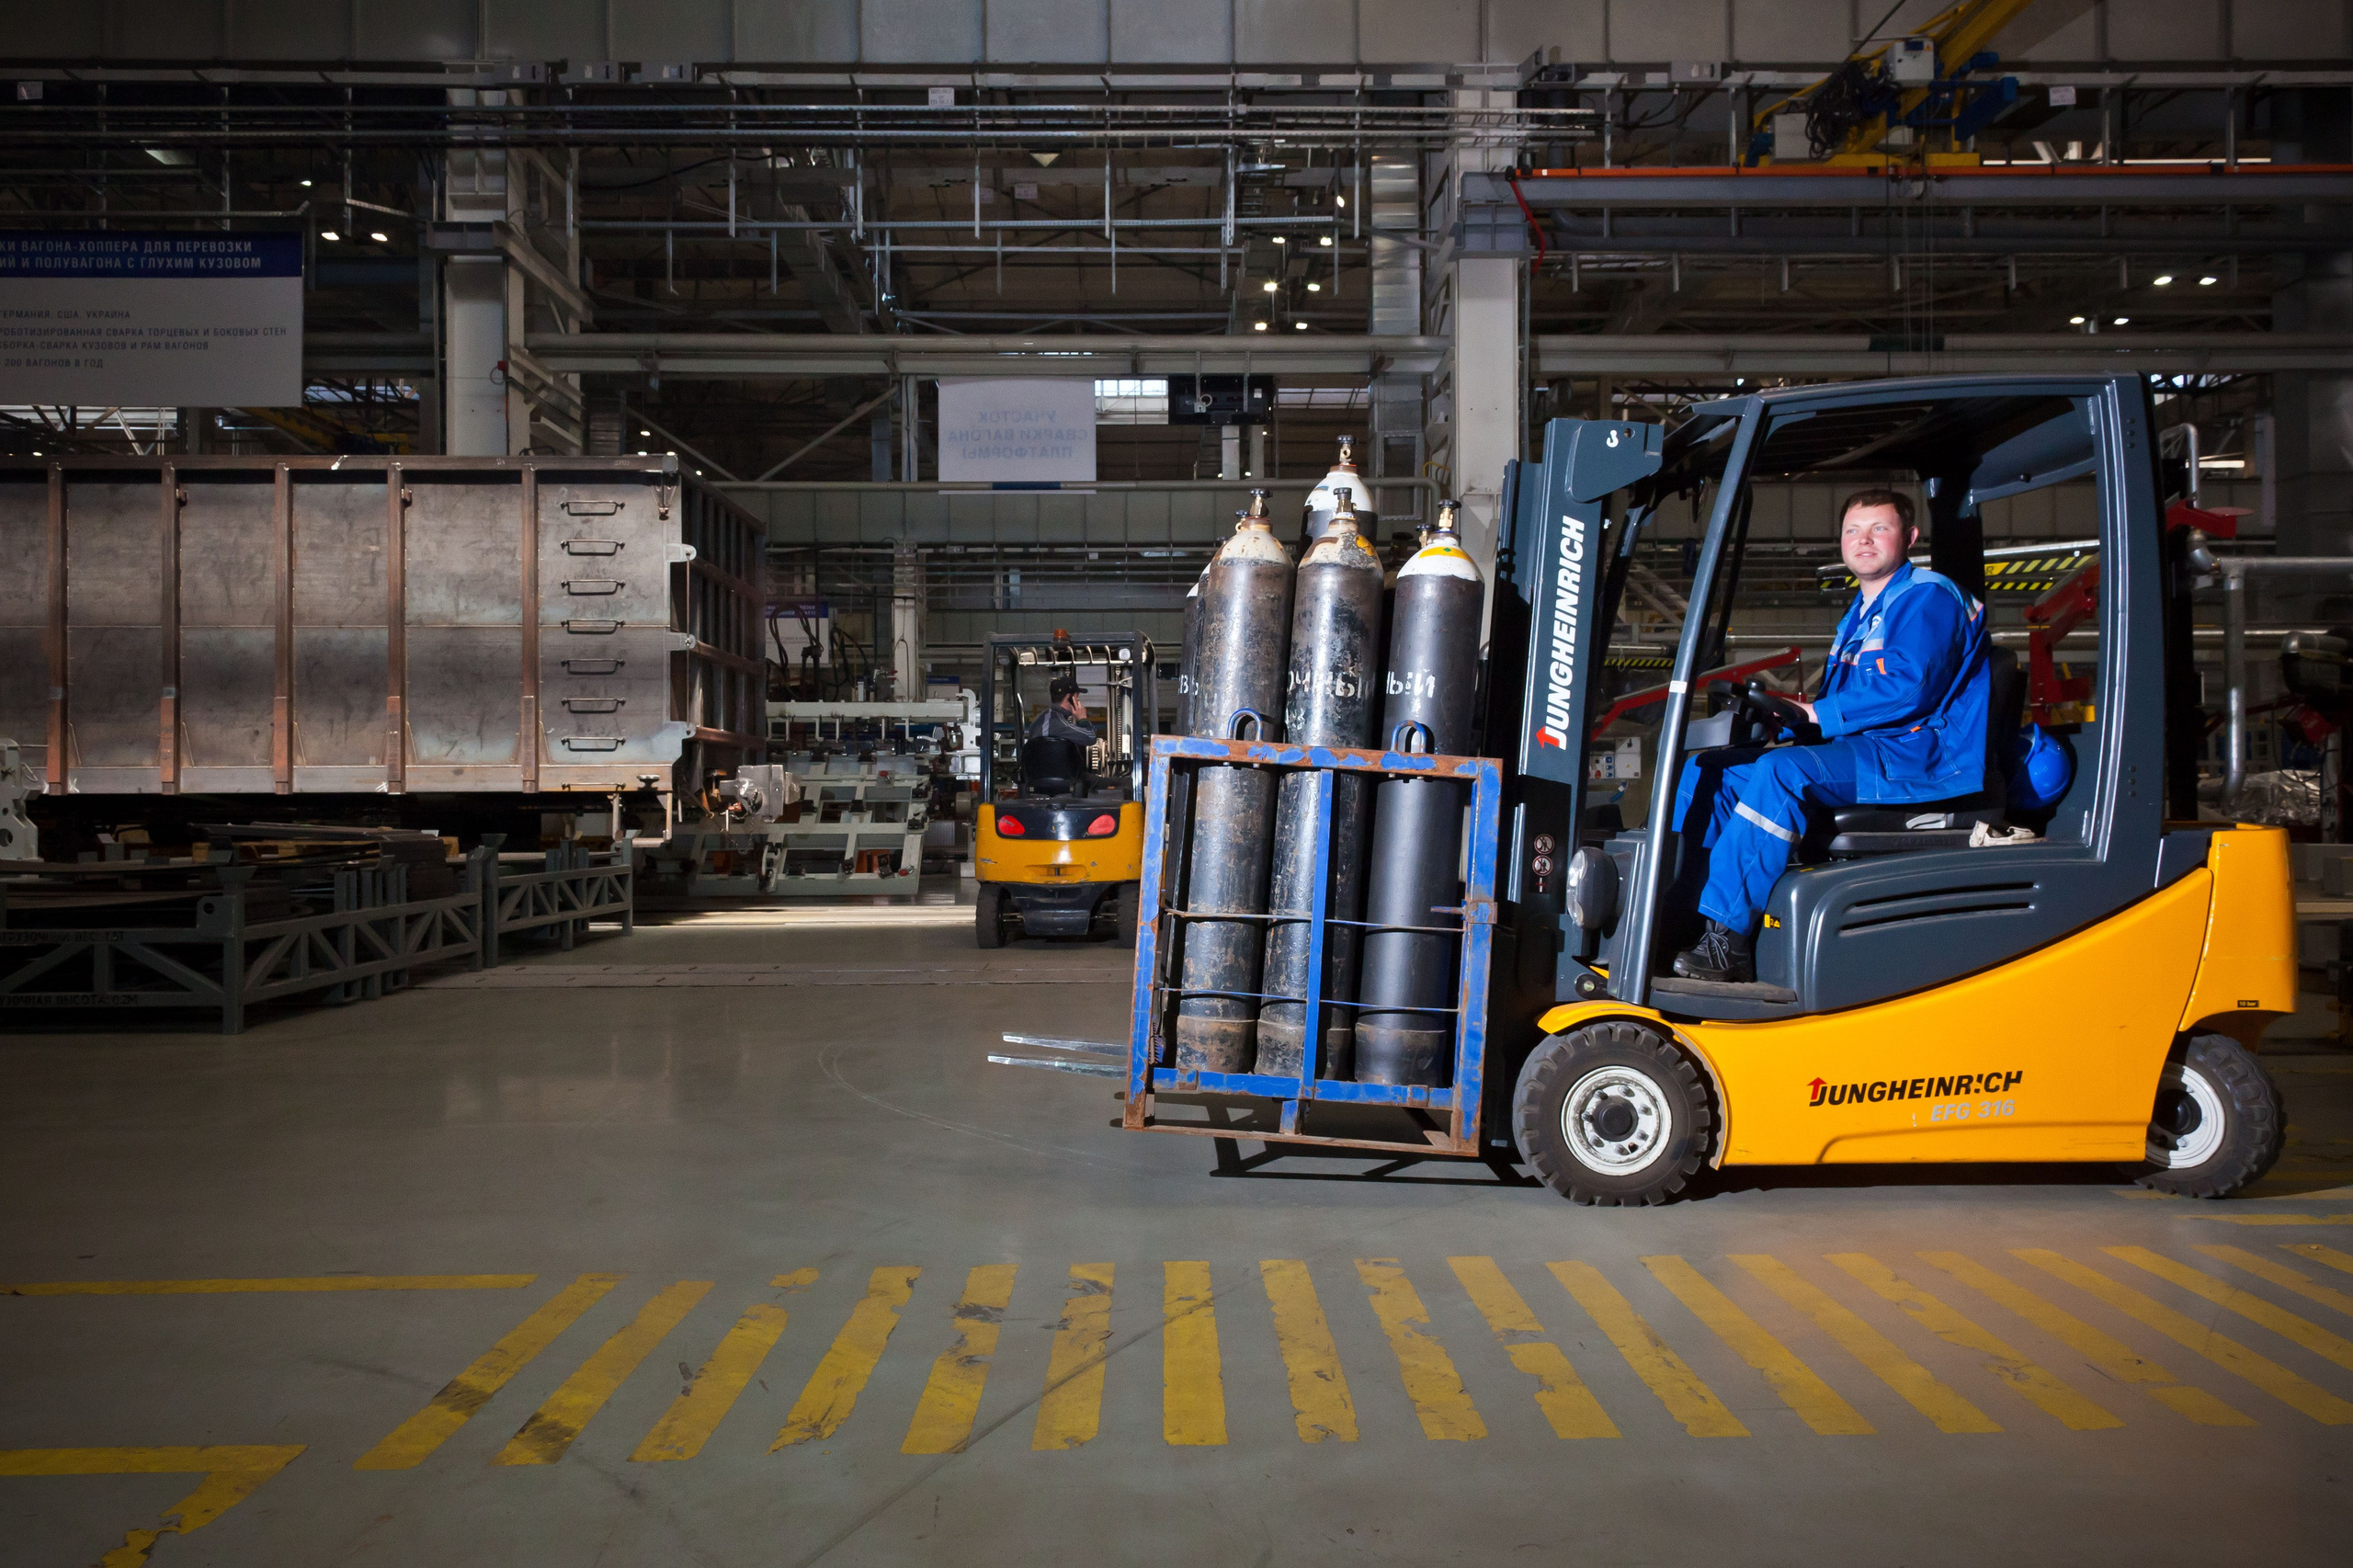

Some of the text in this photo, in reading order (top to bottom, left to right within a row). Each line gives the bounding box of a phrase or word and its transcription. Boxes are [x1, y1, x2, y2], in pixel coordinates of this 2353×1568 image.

[21, 241, 138, 253] ВАГОНА-ХОППЕРА
[144, 241, 171, 254] ДЛЯ
[176, 241, 252, 253] ПЕРЕВОЗКИ
[21, 257, 29, 268] И
[35, 257, 121, 269] ПОЛУВАГОНА
[127, 257, 135, 268] С
[141, 257, 194, 269] ГЛУХИМ
[199, 257, 261, 269] КУЗОВОМ
[0, 311, 52, 319] ЕРМАНИЯ,
[86, 311, 131, 319] УКРАИНА
[106, 328, 143, 336] СВАРКА
[148, 327, 199, 337] ТОРЦЕВЫХ
[203, 327, 210, 336] И
[213, 327, 258, 336] БОКОВЫХ
[263, 327, 287, 336] СТЕН
[82, 341, 127, 350] КУЗОВОВ
[131, 341, 137, 349] И
[141, 341, 161, 350] РАМ
[165, 341, 210, 350] ВАГОНОВ
[5, 358, 104, 369] 200 ВАГОНОВ В ГОД
[1543, 515, 1585, 750] JUNGHEINRICH
[1808, 1071, 2023, 1107] JUNGHEINRICH
[1930, 1099, 2016, 1122] EFG 316
